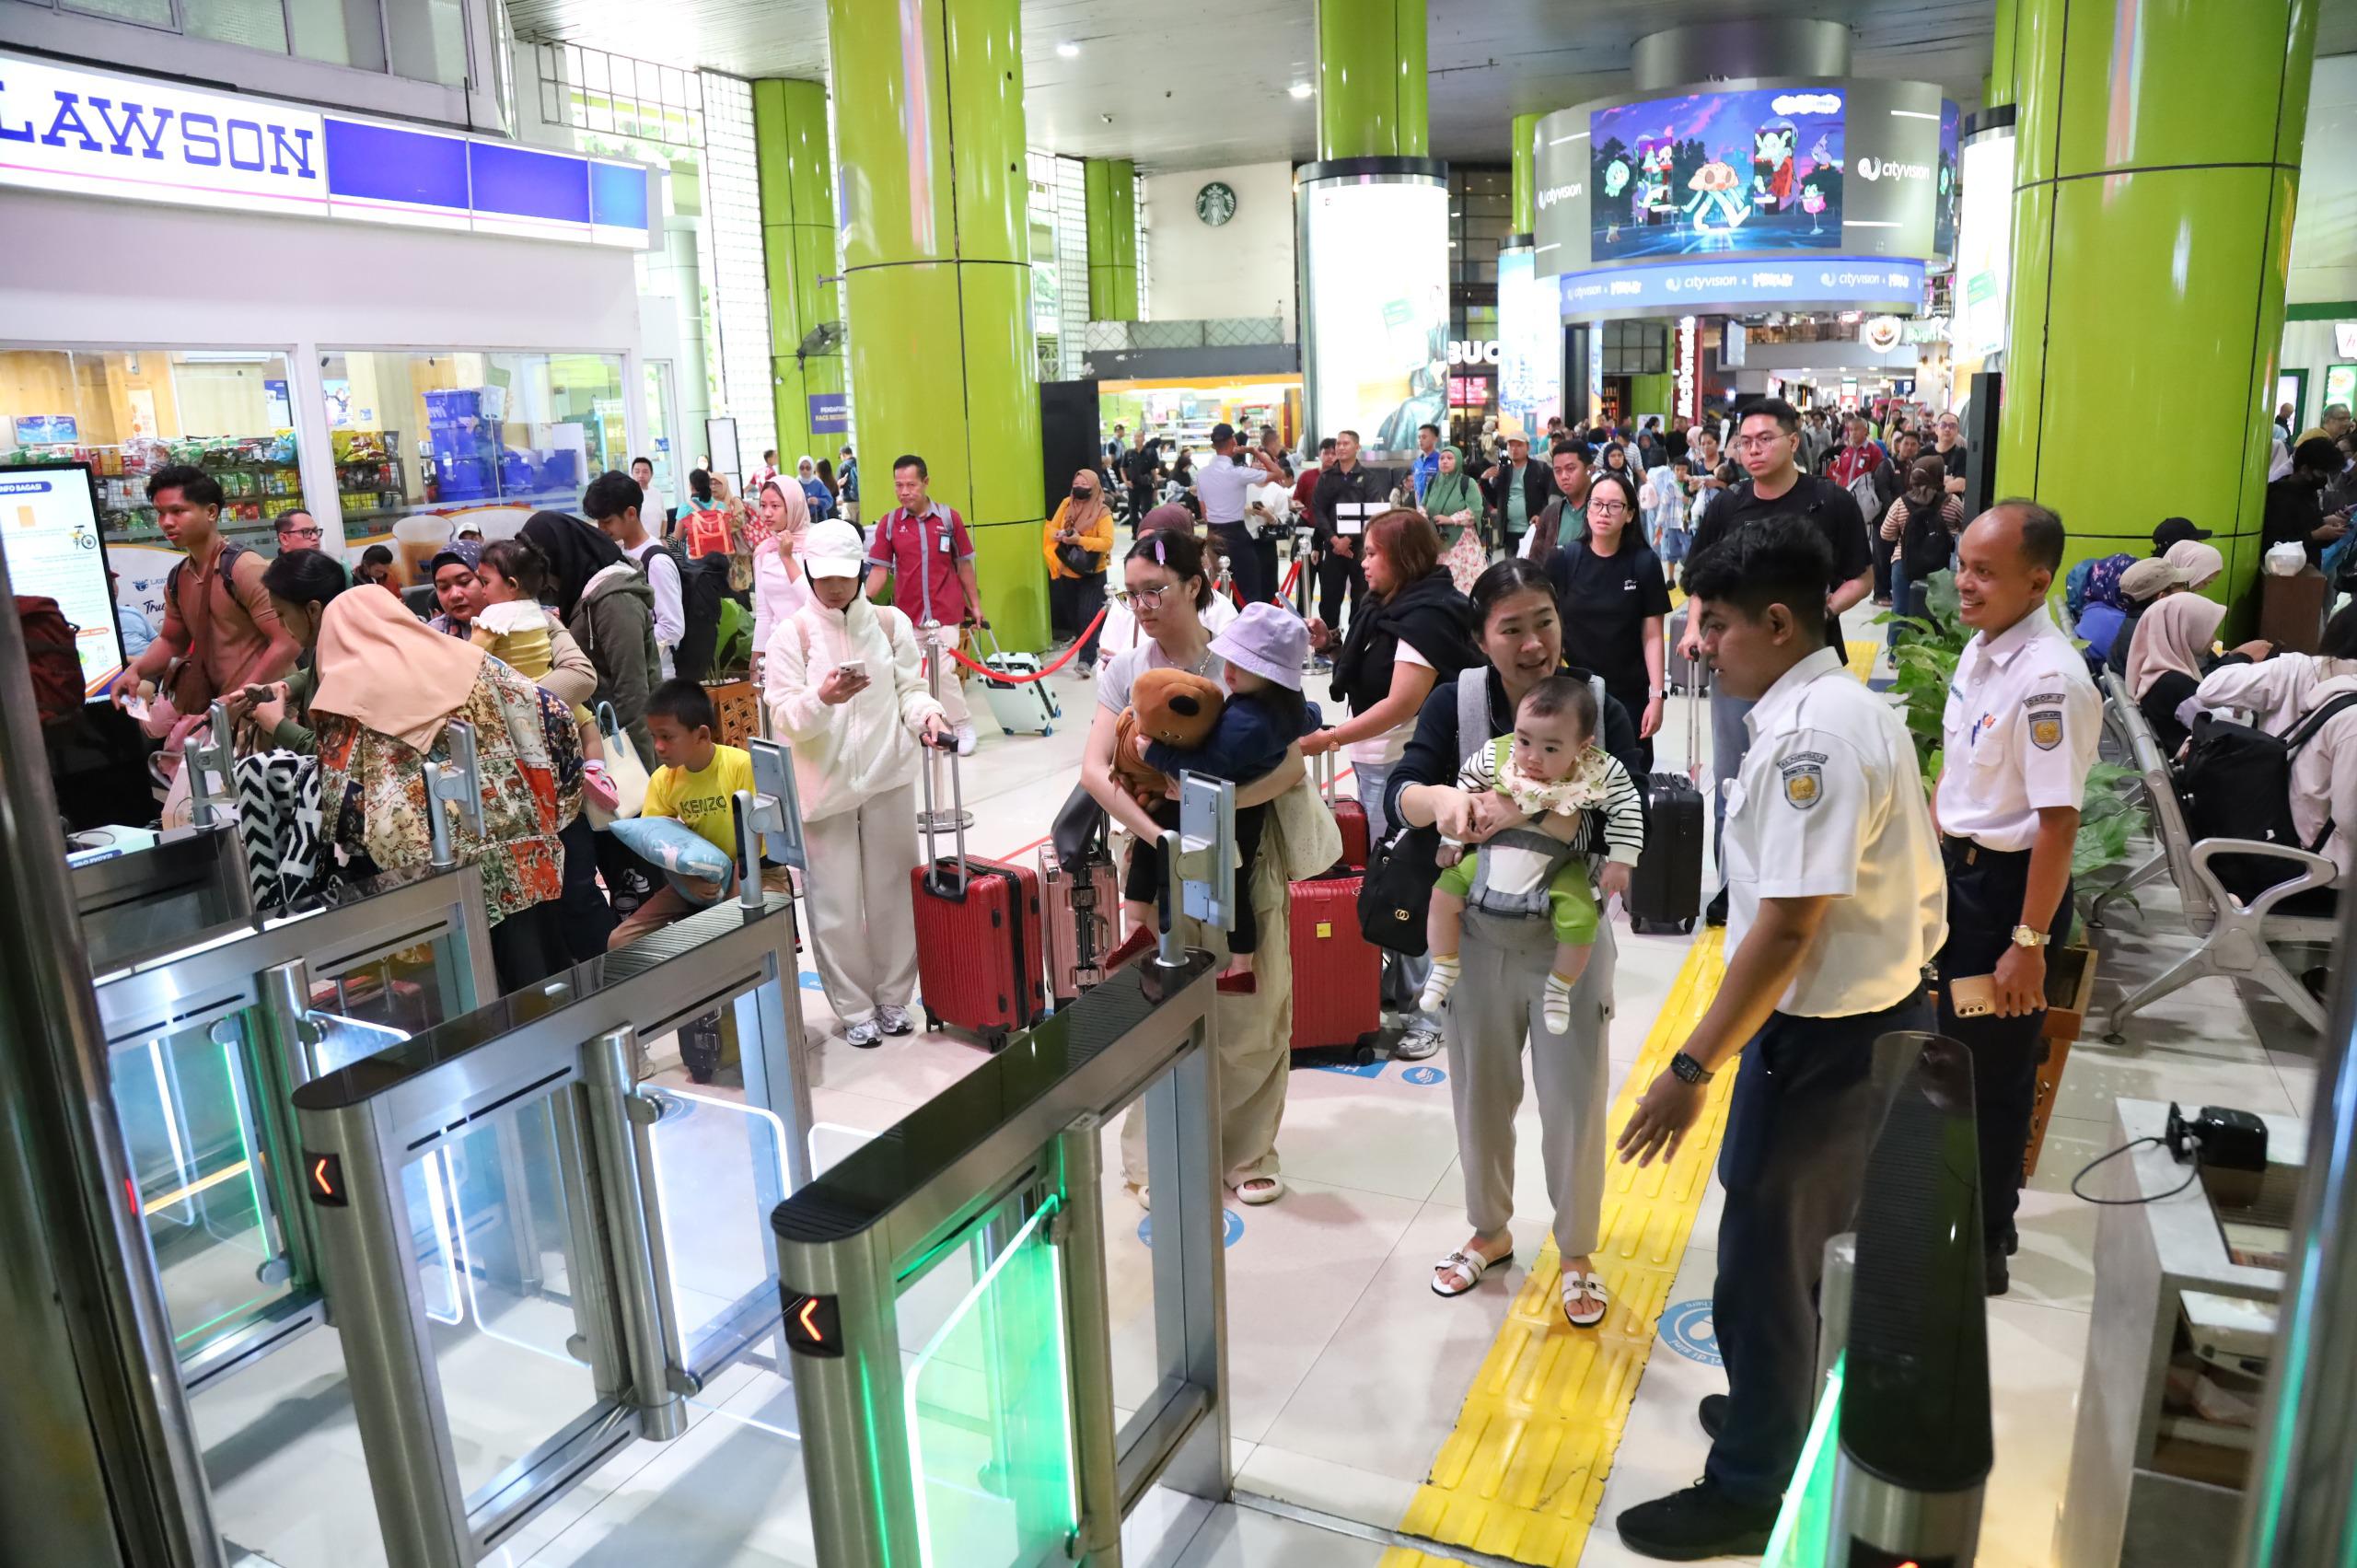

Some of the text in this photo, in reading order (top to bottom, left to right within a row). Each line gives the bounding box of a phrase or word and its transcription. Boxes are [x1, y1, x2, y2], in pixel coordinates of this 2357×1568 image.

[0, 80, 317, 180] LAWSON
[1882, 160, 1930, 181] cityvision
[1684, 275, 1738, 291] cityvision
[1839, 272, 1879, 287] cityvision
[16, 483, 42, 492] BAGASI
[2028, 694, 2052, 706] DAOP
[679, 796, 727, 814] KENZO
